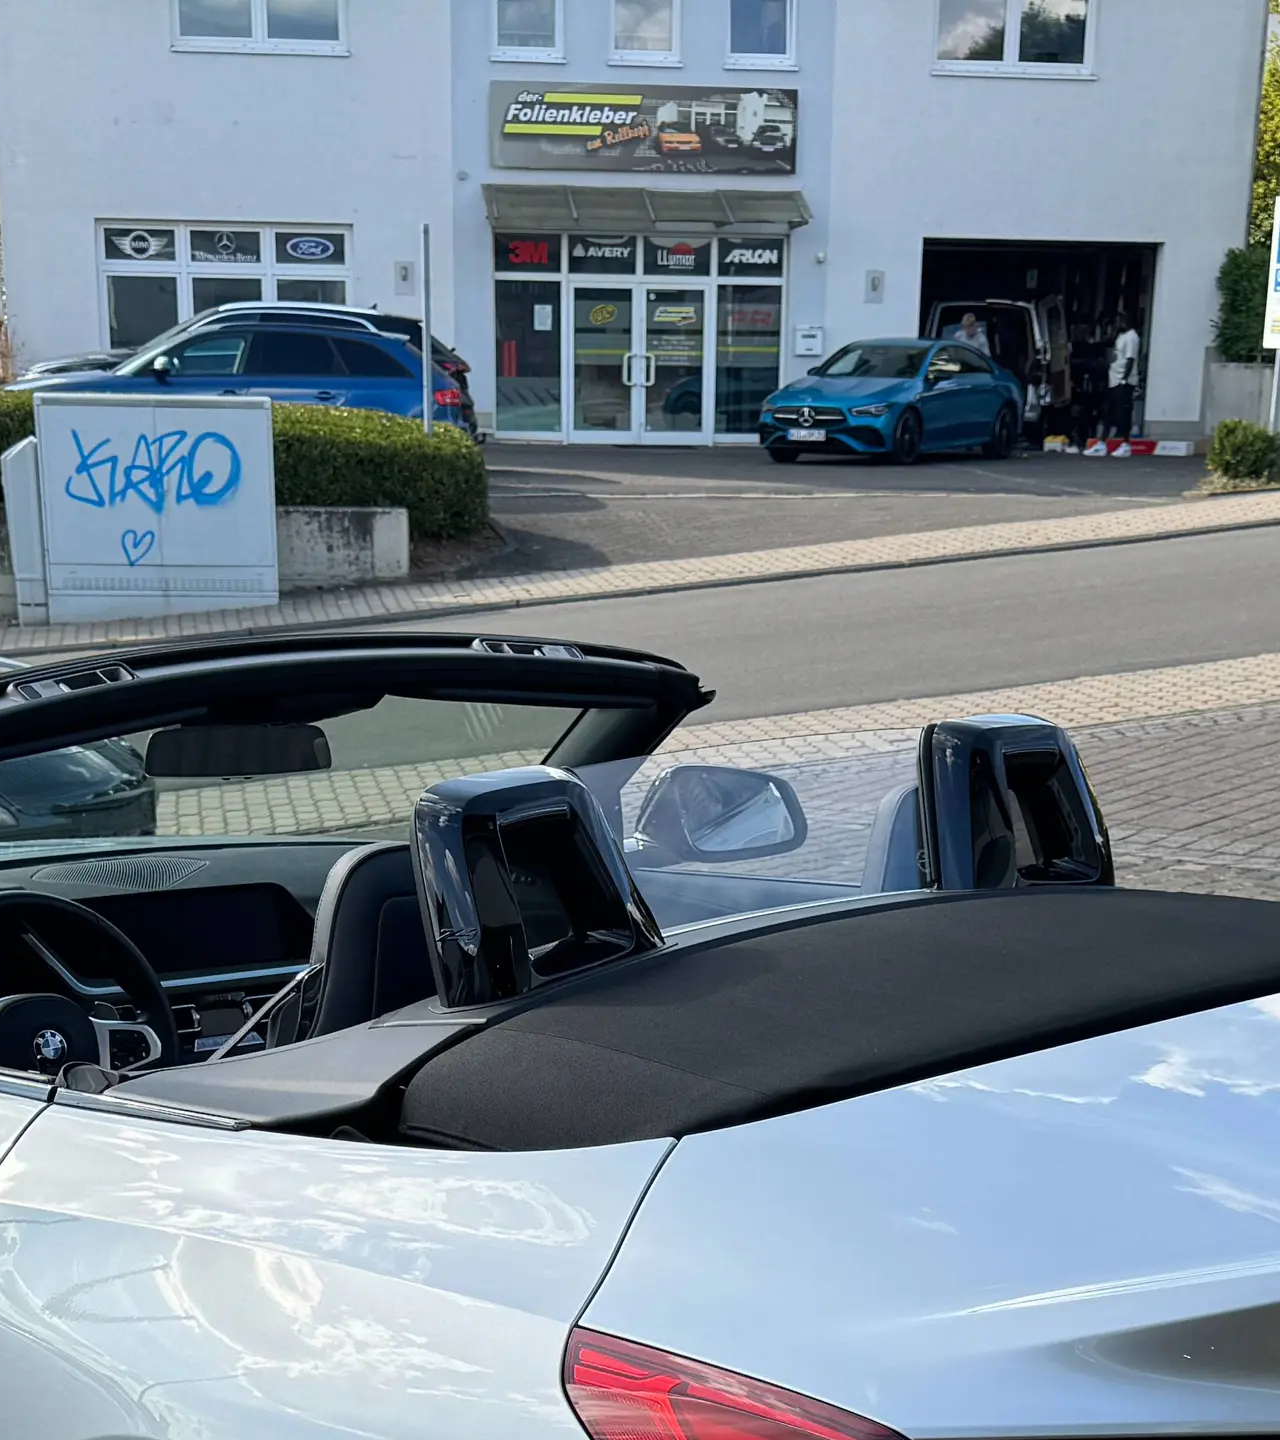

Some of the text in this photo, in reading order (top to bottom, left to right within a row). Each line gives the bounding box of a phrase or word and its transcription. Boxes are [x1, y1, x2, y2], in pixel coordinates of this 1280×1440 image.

[505, 104, 637, 125] Folienkleber
[296, 241, 324, 255] Ford
[508, 241, 548, 264] 3M
[586, 246, 632, 258] AVERY
[724, 248, 779, 264] ARLON
